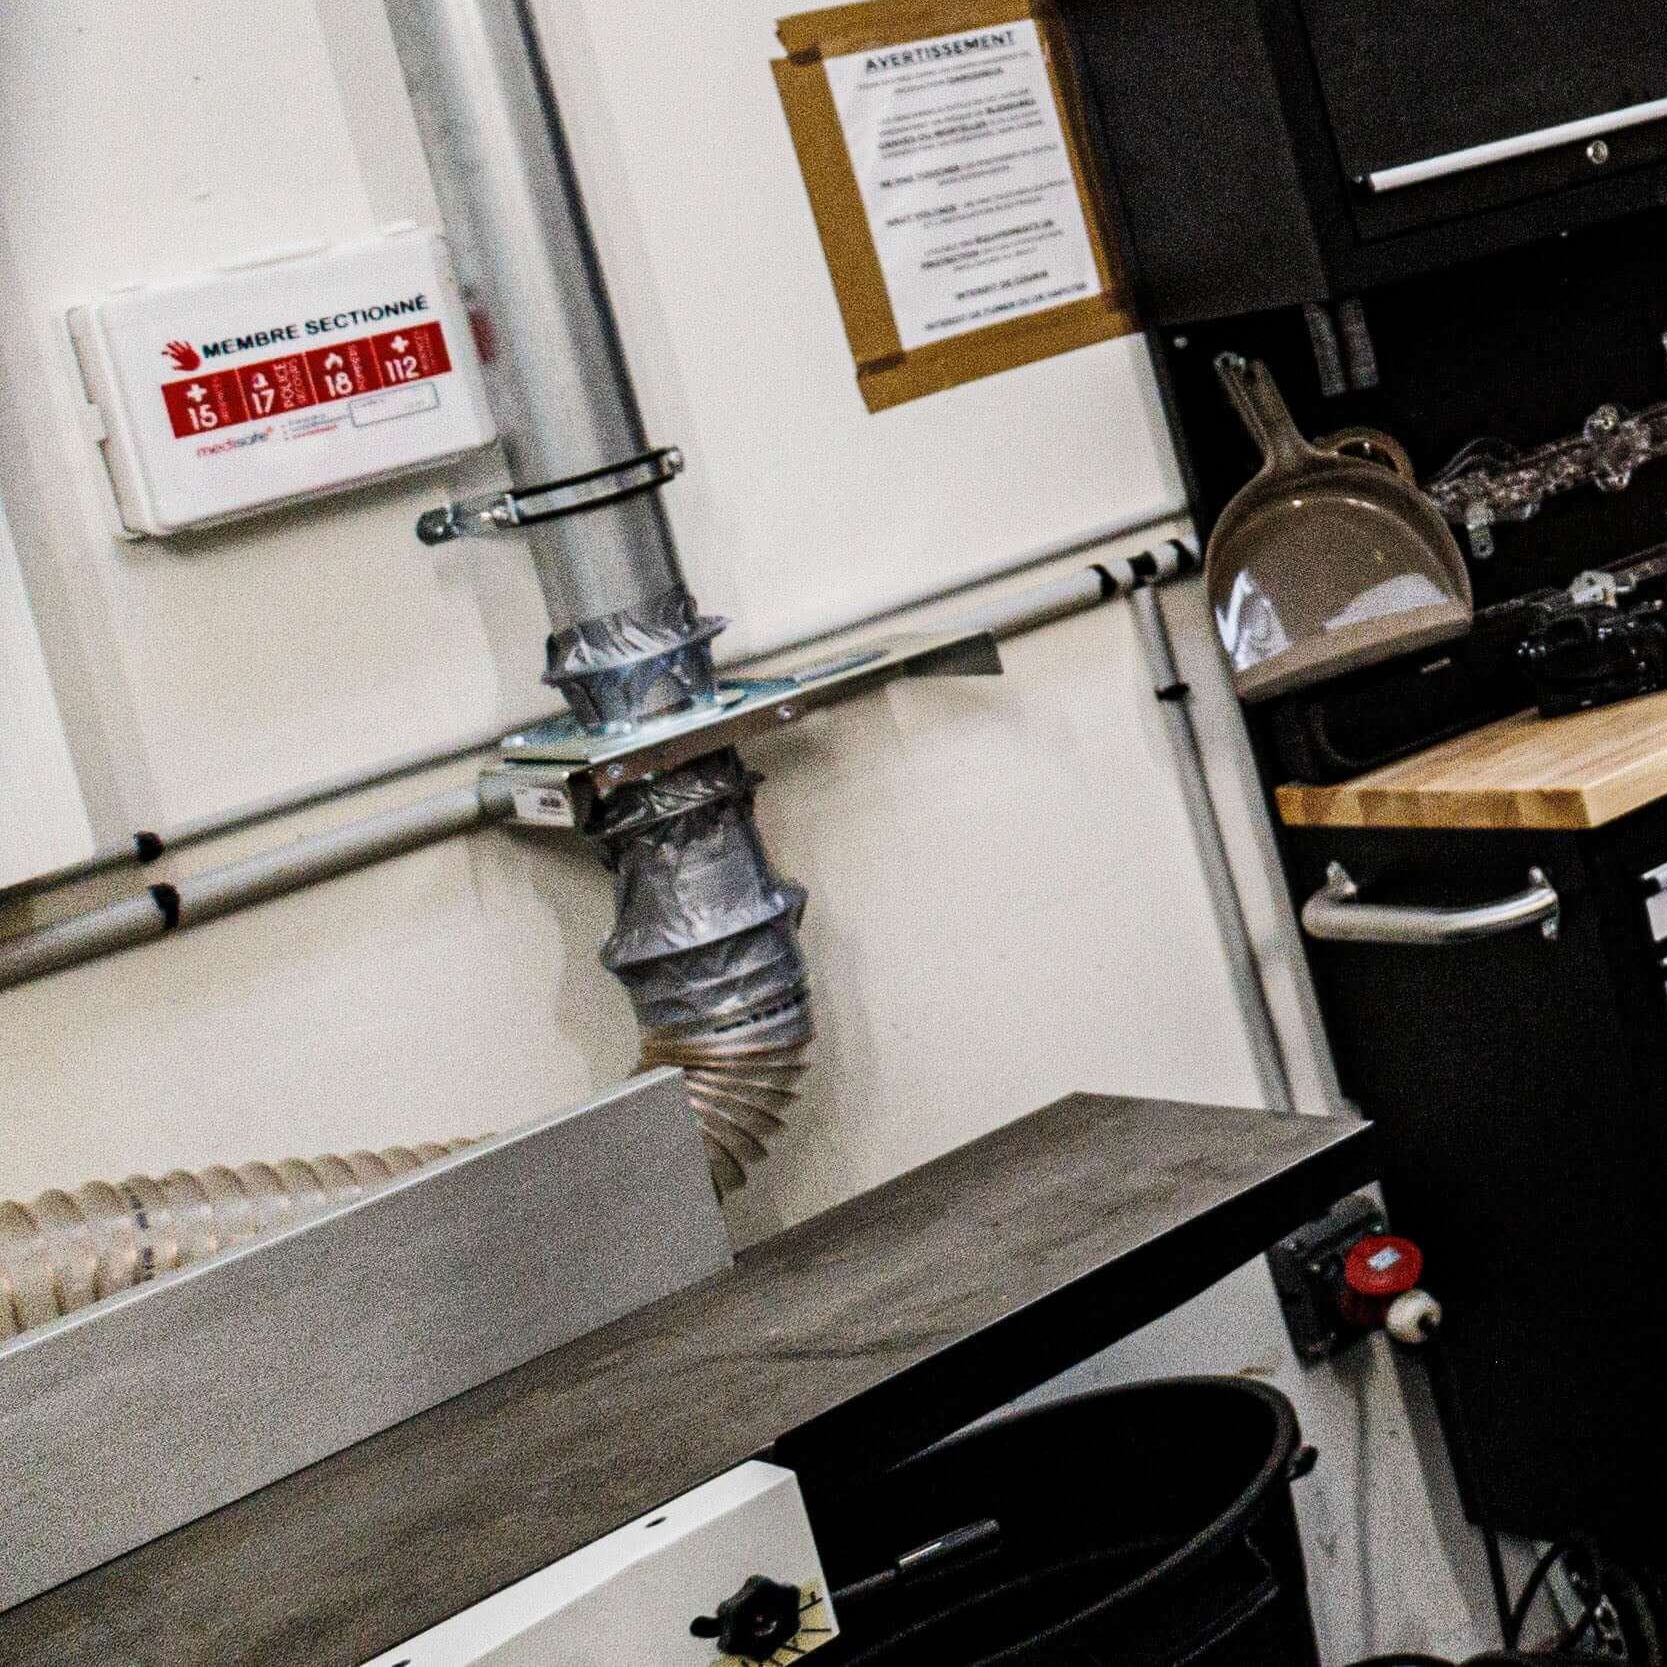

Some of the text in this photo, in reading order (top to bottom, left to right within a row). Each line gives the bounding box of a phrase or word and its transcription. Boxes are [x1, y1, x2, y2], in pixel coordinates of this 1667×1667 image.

[865, 30, 1017, 74] AVERTISSEMENT
[202, 294, 430, 360] MEMBRE SECTIONNÉ
[385, 356, 420, 382] 112
[273, 361, 294, 409] POLICE
[324, 371, 353, 396] 18
[251, 389, 275, 415] 17
[186, 404, 218, 431] 15
